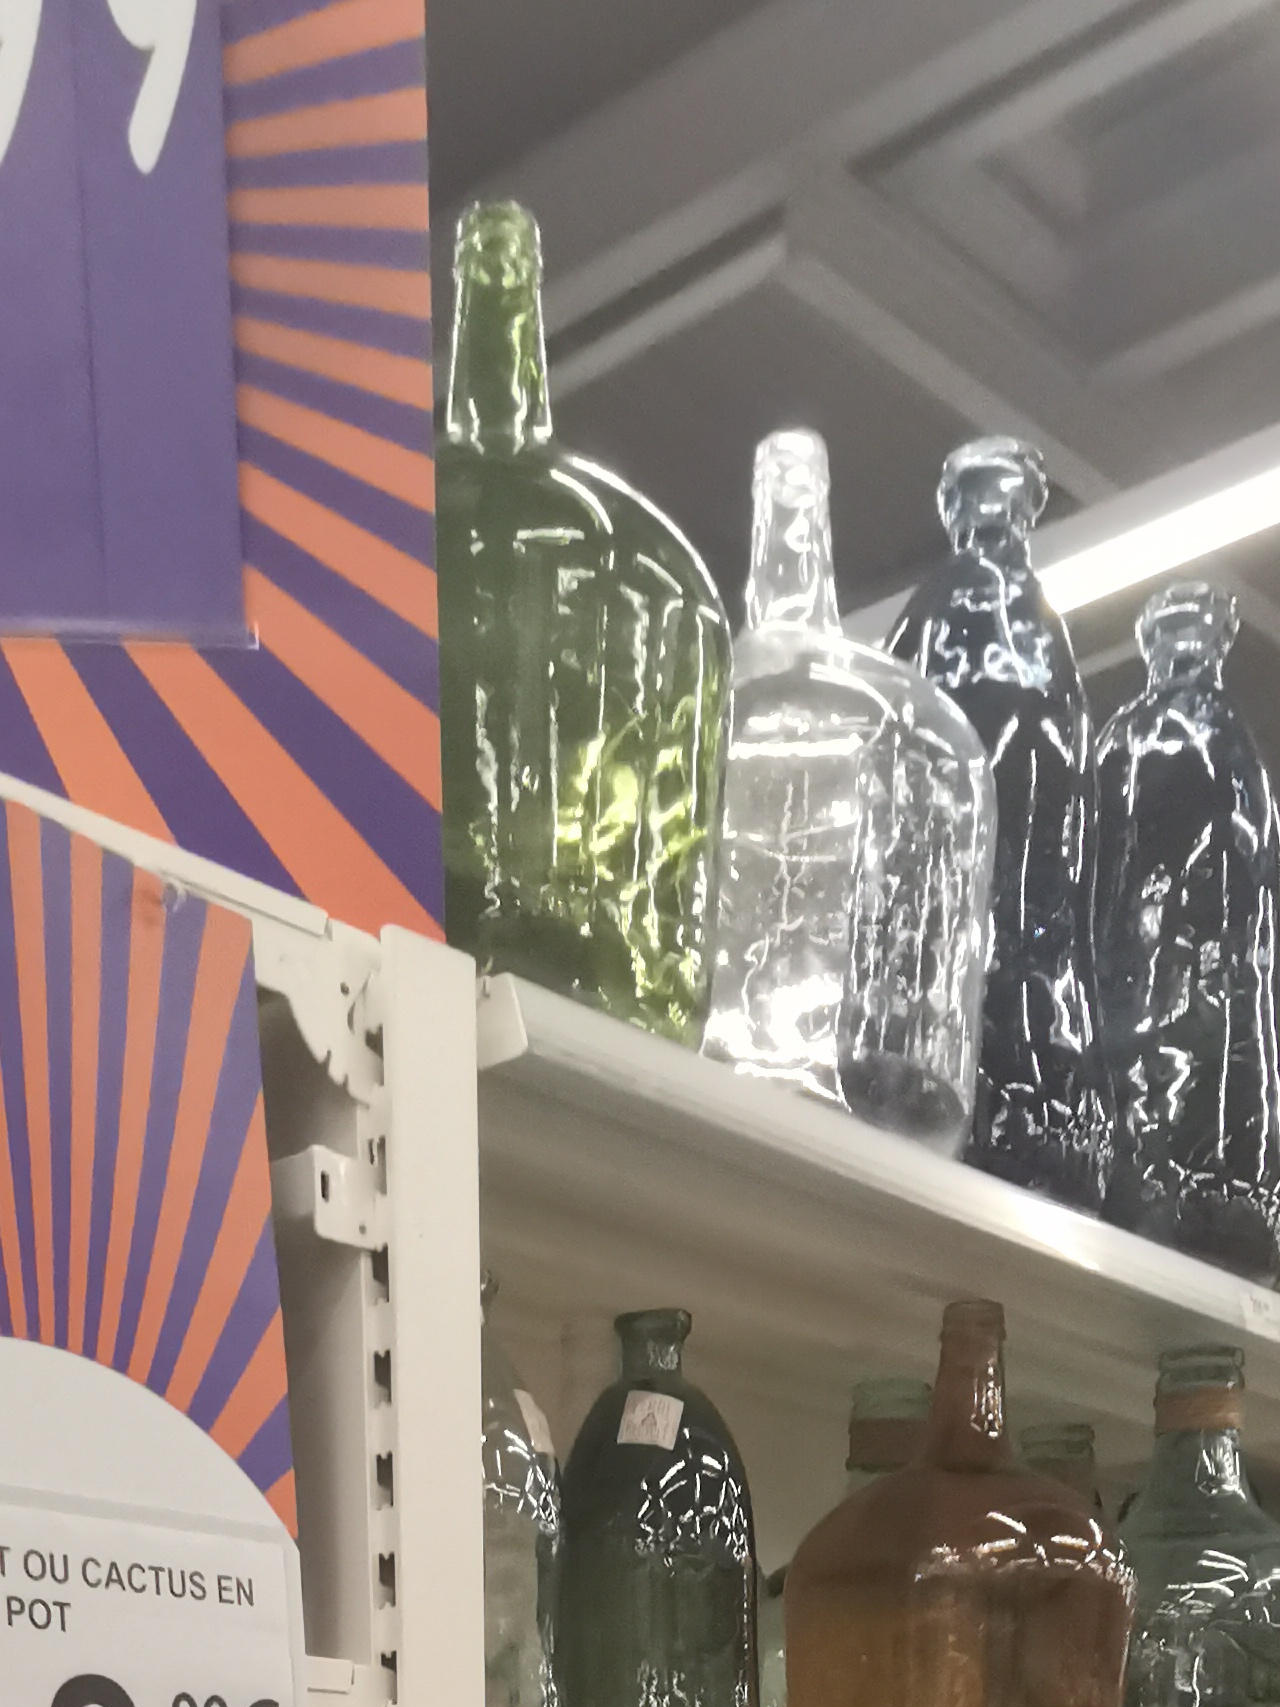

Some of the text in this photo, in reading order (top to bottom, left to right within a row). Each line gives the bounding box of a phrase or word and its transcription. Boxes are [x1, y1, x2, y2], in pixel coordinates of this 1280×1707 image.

[23, 1549, 70, 1585] OU
[81, 1557, 208, 1602] CACTUS
[217, 1574, 255, 1608] EN
[6, 1595, 72, 1633] POT
